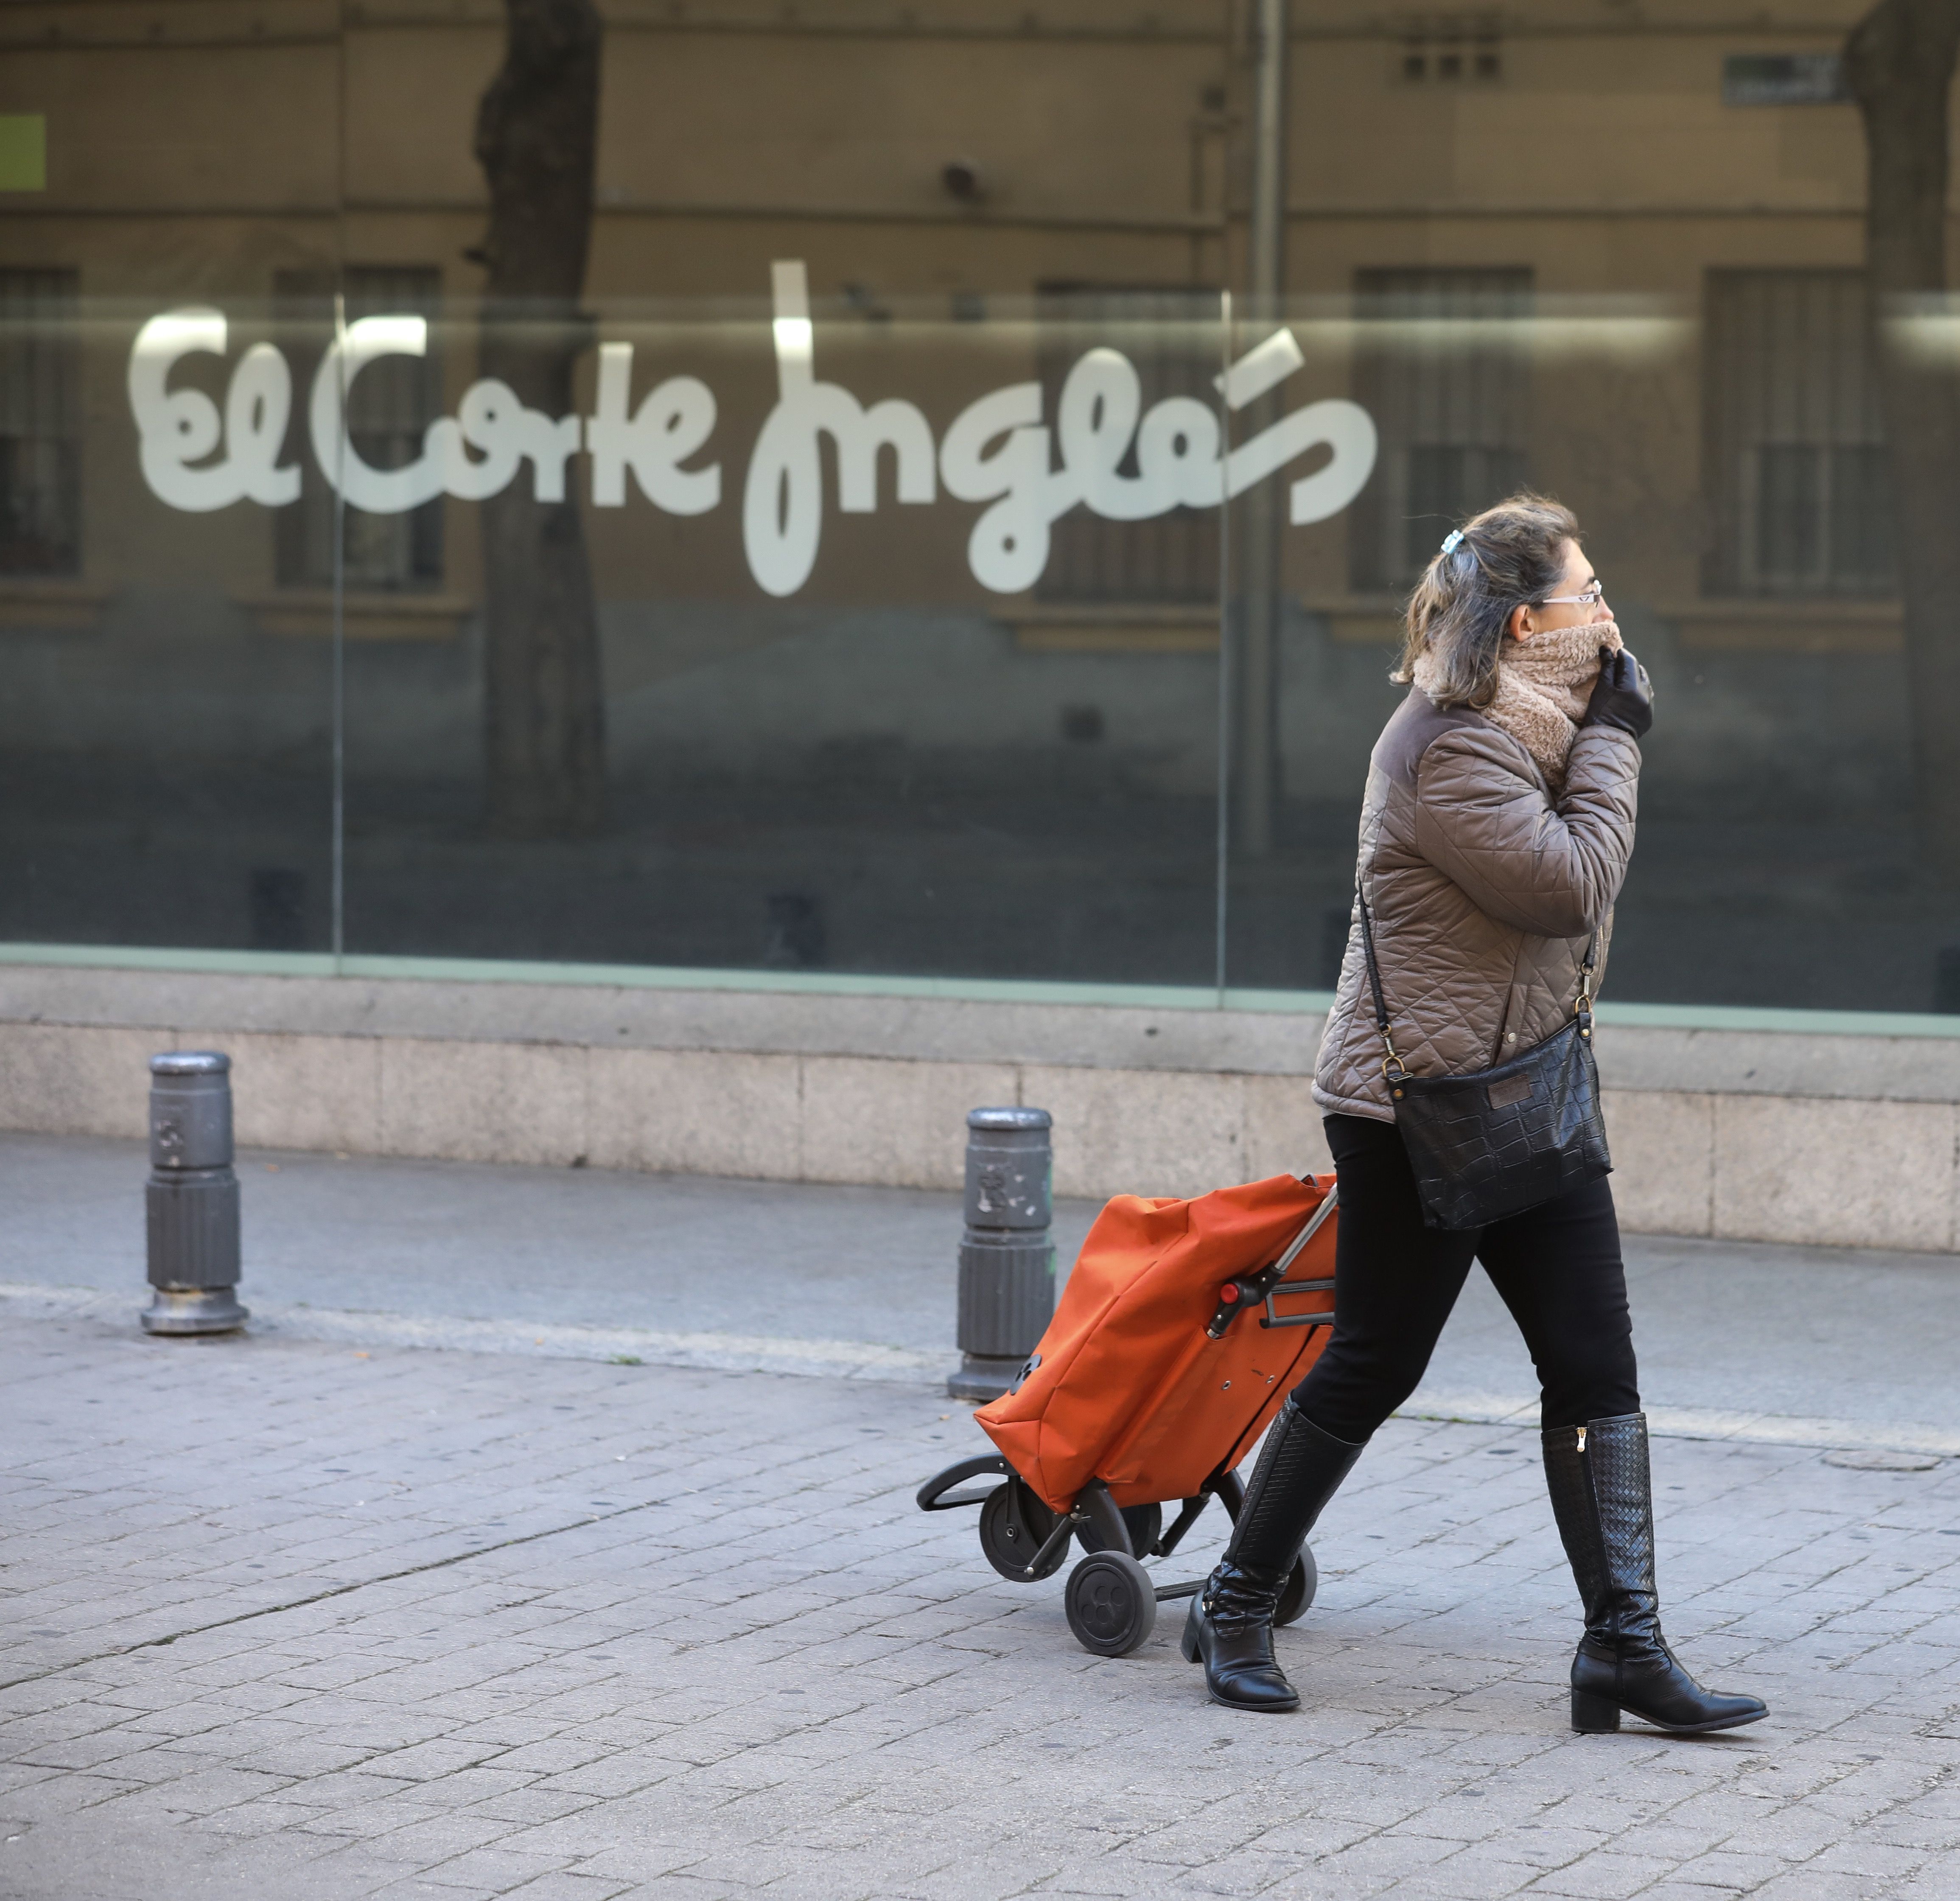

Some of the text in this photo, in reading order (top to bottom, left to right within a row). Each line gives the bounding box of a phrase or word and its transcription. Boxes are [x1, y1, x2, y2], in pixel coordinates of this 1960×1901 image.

[128, 260, 1377, 596] El Corte Inglés
